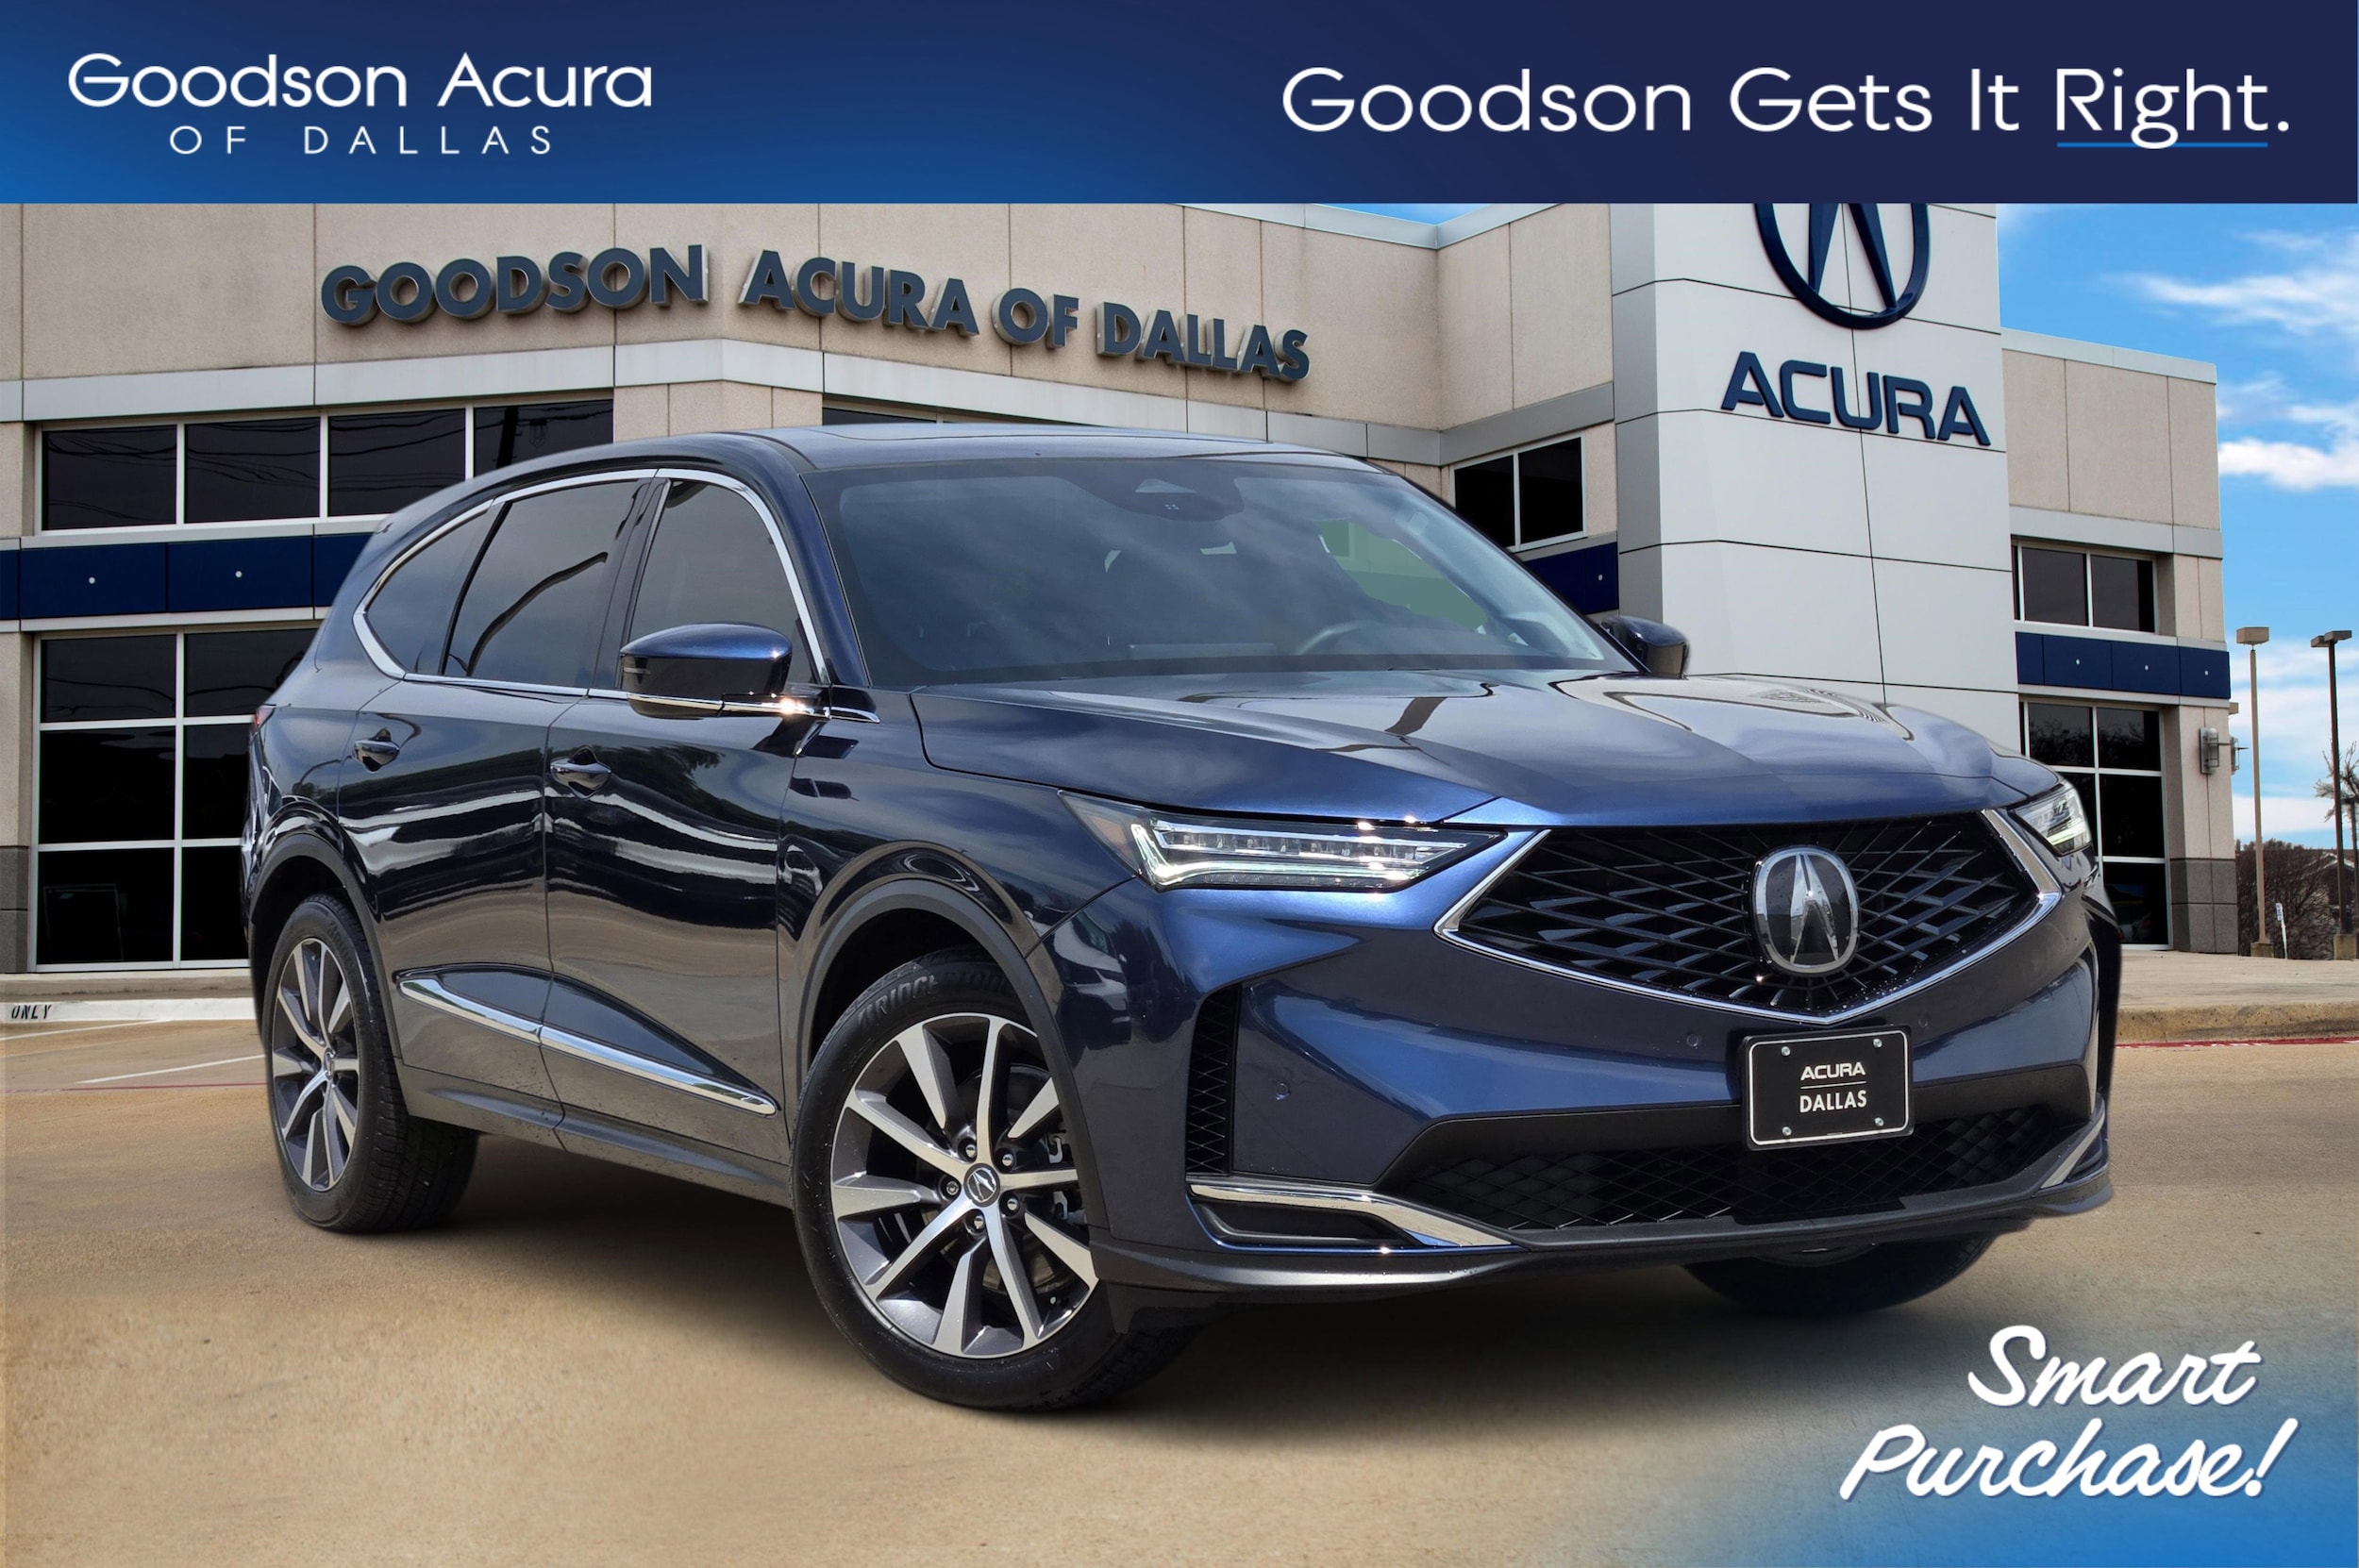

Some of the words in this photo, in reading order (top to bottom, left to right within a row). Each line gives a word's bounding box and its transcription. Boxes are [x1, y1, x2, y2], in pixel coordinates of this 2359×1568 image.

[321, 243, 709, 326] GOODSON
[738, 249, 979, 337] ACURA
[992, 287, 1079, 349] OF
[1096, 301, 1310, 382] DALLAS
[1720, 350, 1991, 446] ACURA
[10, 1004, 52, 1020] ONLY
[1800, 1061, 1866, 1081] ACURA
[1799, 1090, 1867, 1113] DALLAS
